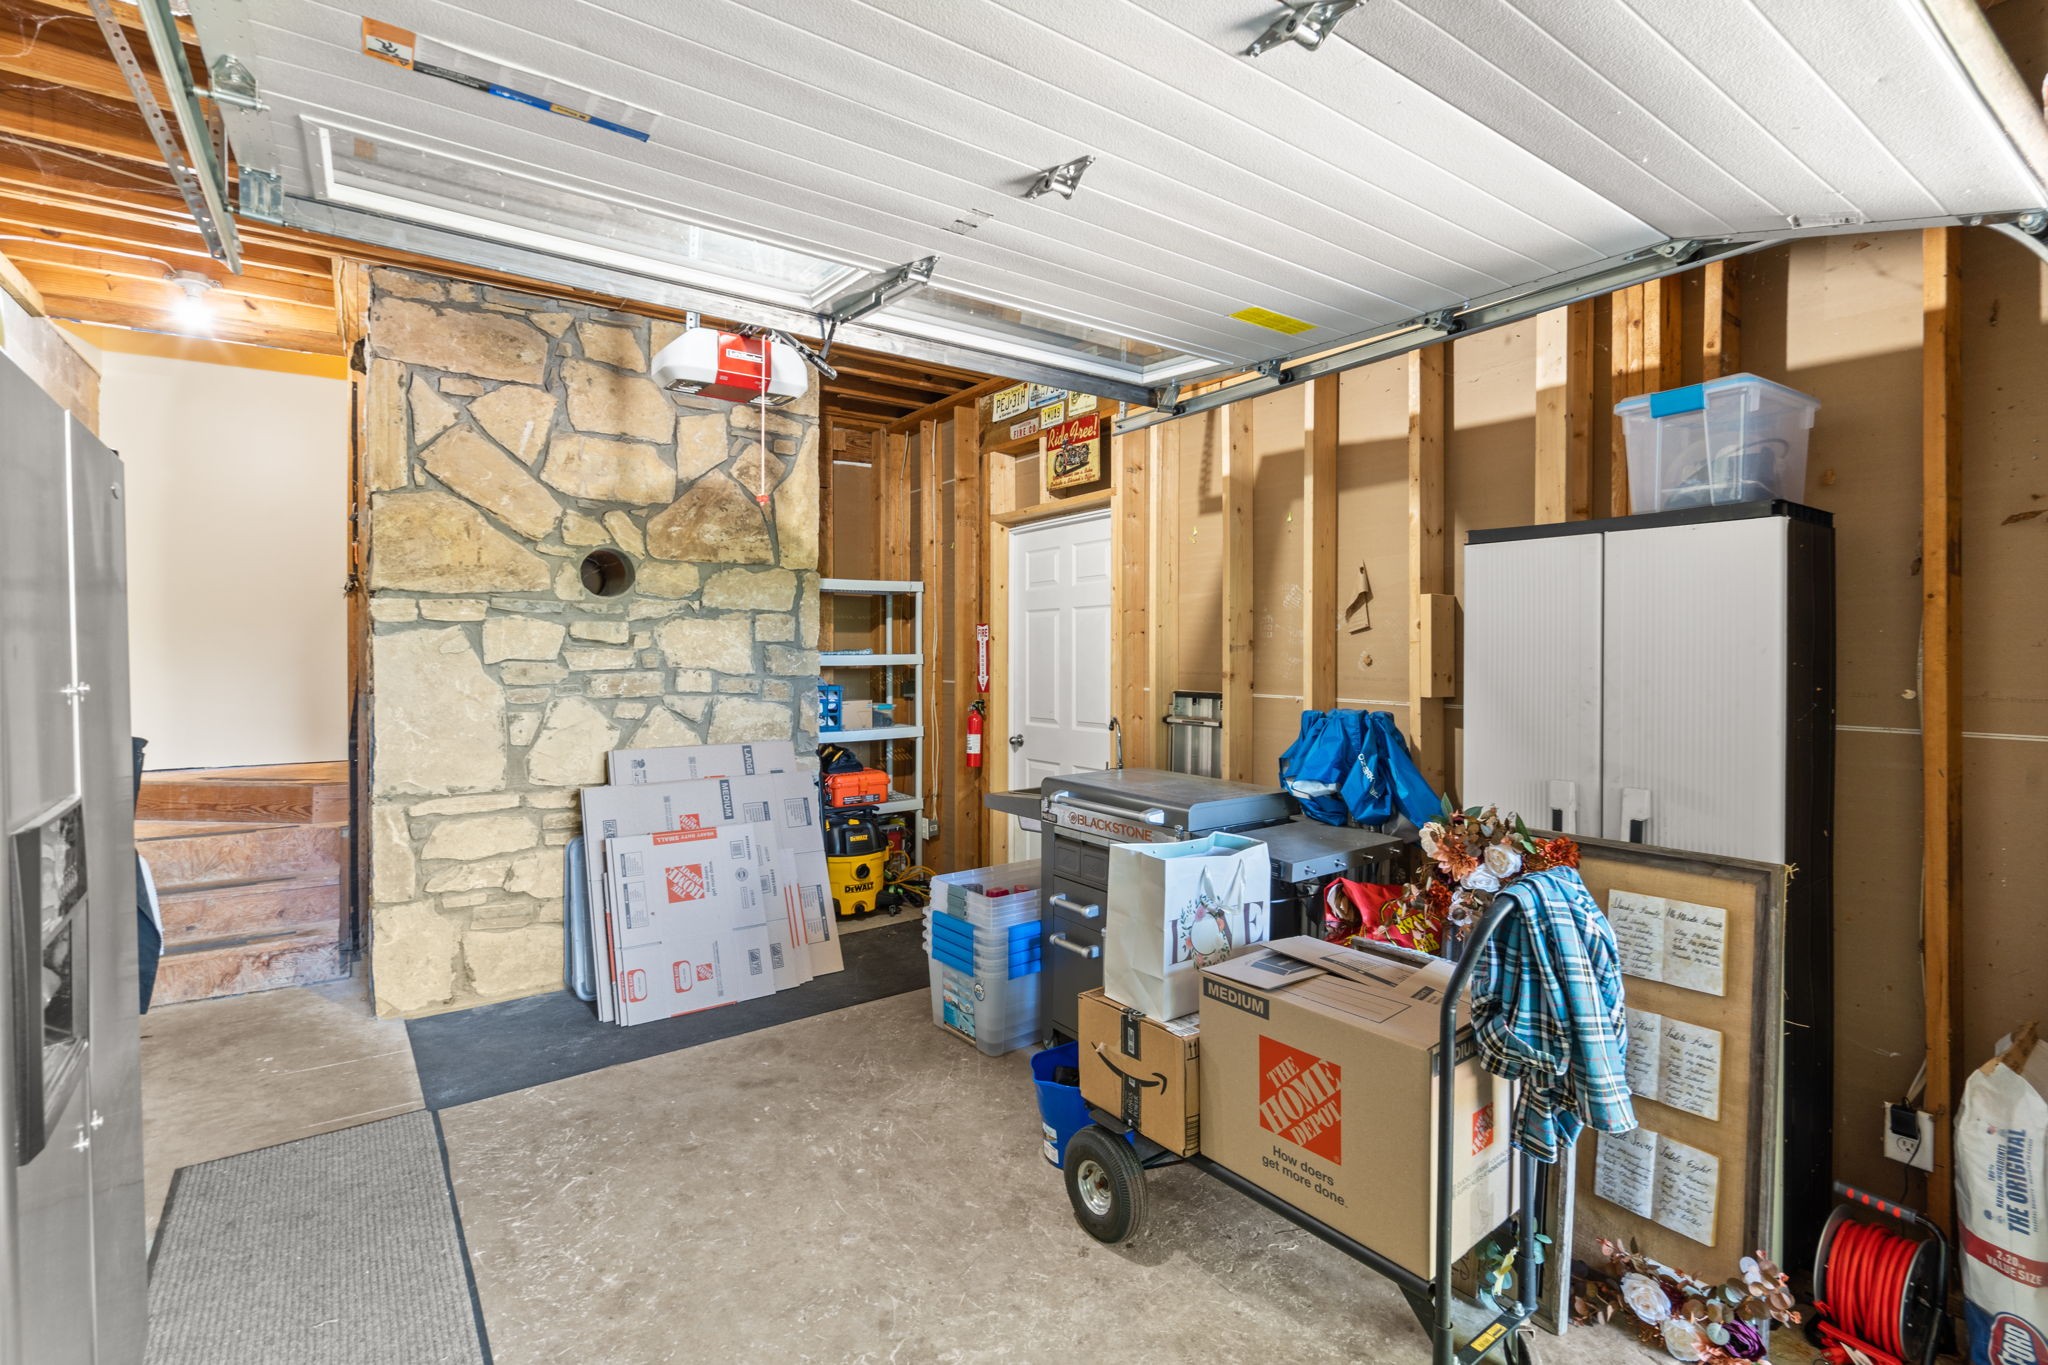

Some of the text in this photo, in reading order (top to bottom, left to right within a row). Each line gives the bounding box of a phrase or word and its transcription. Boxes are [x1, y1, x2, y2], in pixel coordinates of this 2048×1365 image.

[1047, 415, 1097, 448] Ride Free!
[743, 749, 752, 774] LARGE
[722, 782, 732, 817] MEDIUM
[1077, 814, 1153, 843] BLACKSTONE
[1208, 982, 1265, 1014] MEDIUM
[1266, 1056, 1300, 1089] THE
[1259, 1059, 1342, 1134] HOME
[1290, 1100, 1343, 1146] DEPOT
[1262, 1155, 1349, 1209] get more done.
[1272, 1145, 1335, 1188] How doers
[2005, 1129, 2030, 1236] THE ORIGINAL
[1985, 1252, 2043, 1286] VALUE SIZE
